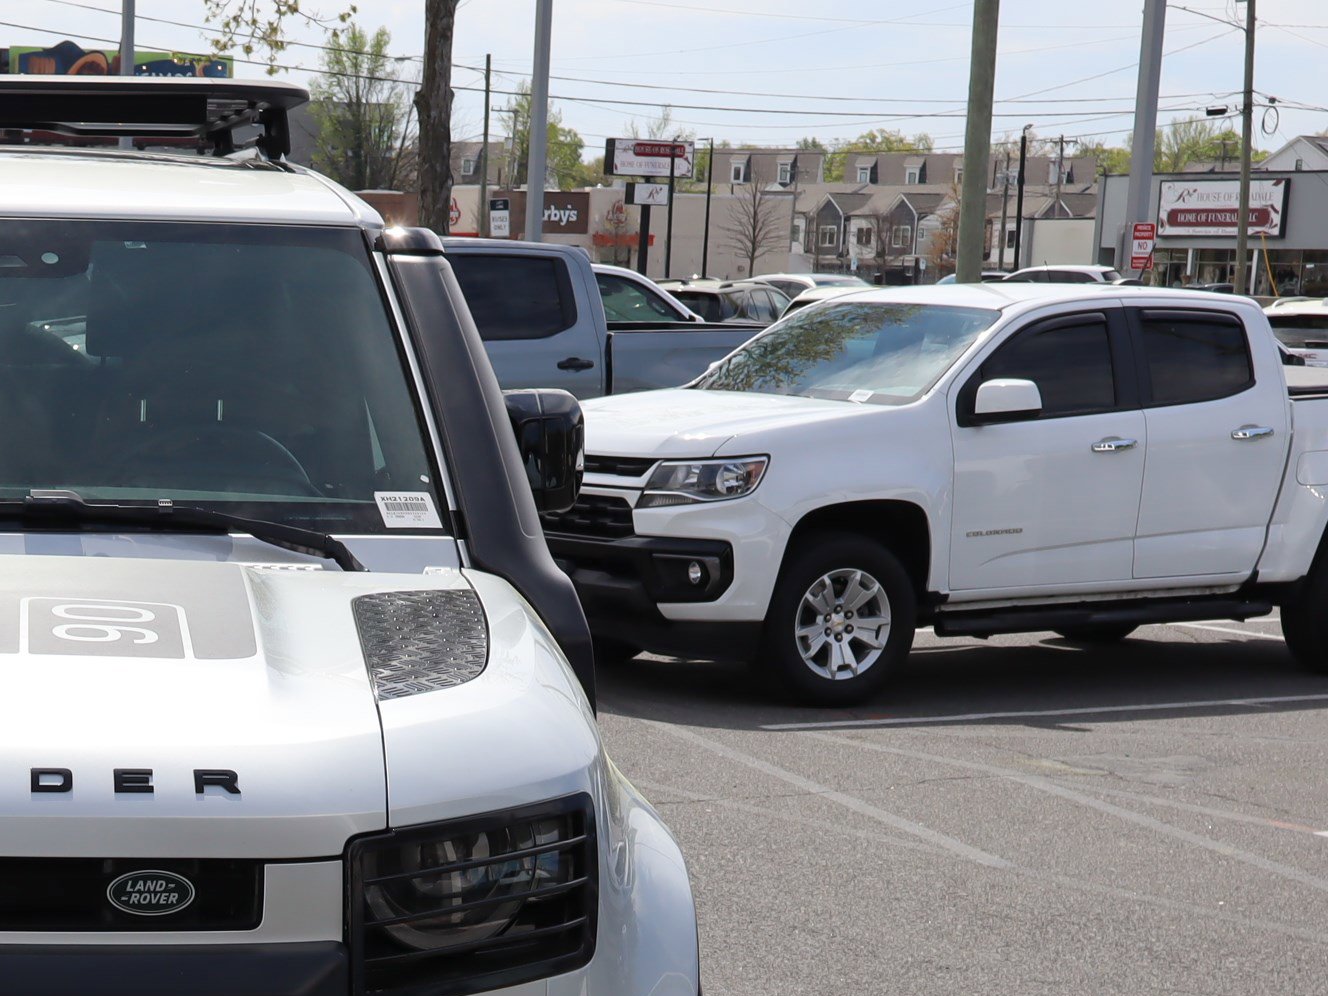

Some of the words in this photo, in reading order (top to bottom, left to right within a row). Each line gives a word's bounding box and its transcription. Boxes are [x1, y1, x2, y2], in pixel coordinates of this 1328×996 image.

[543, 204, 578, 226] rby's
[1177, 212, 1197, 222] HOME
[1197, 212, 1207, 222] OF
[1208, 212, 1239, 222] FUNERAL
[1137, 241, 1148, 250] NO
[126, 880, 167, 892] LAND
[129, 892, 179, 905] ROVER
